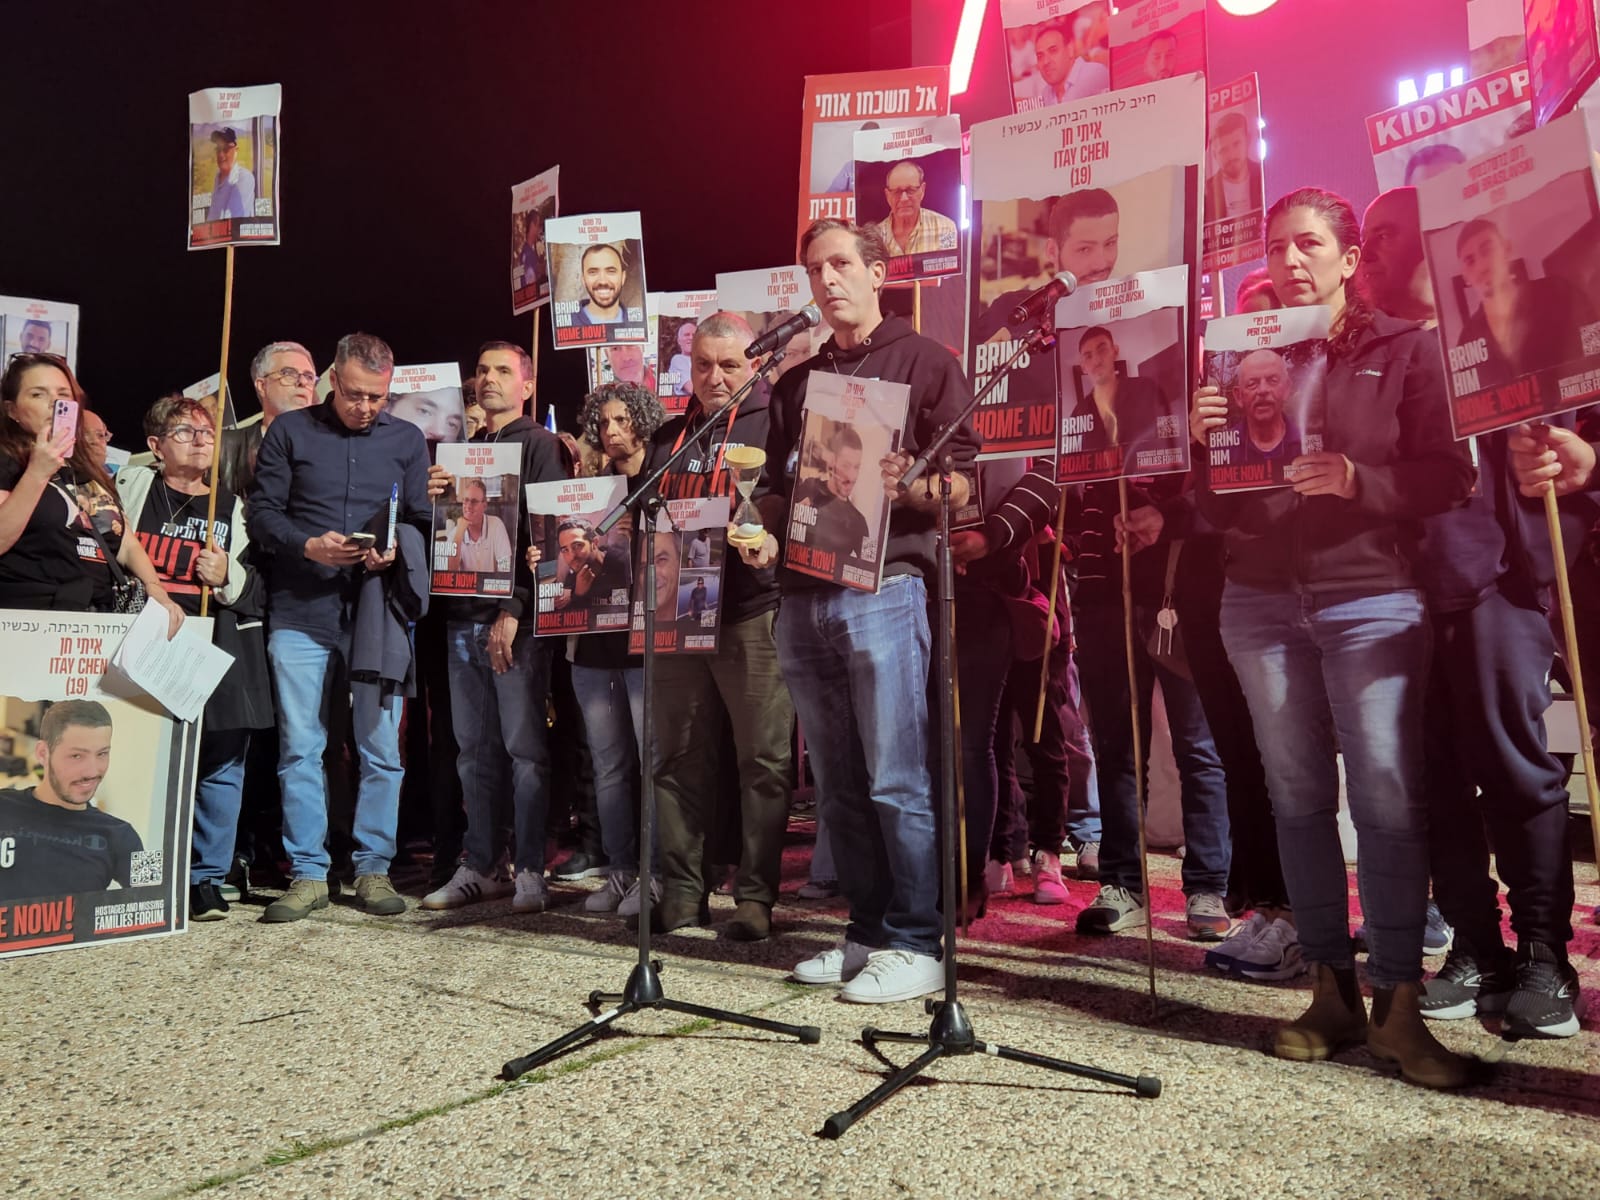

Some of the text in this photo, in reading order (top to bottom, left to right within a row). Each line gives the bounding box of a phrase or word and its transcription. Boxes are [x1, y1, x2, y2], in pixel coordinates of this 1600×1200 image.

[815, 85, 938, 118] אל תשכחו אותי
[1092, 98, 1126, 117] לחזור
[1130, 93, 1156, 110] חייב
[1376, 69, 1530, 146] KIDNAPP
[1062, 121, 1103, 148] איתי חן
[883, 140, 910, 150] ABRAHAM
[1054, 141, 1110, 169] ITAY CHEN
[1070, 165, 1092, 189] (19)
[809, 198, 842, 220] בבית
[1214, 216, 1257, 235] Berman
[780, 271, 795, 282] איתי
[768, 283, 799, 297] ITAY CHEN
[554, 300, 580, 314] BRING
[1088, 290, 1145, 312] ROM BRASLAVSKI
[556, 314, 573, 328] HIM
[557, 326, 582, 342] HOME
[582, 324, 607, 339] NOW!
[1246, 325, 1281, 337] PERI CHAIM
[1258, 335, 1272, 346] (79)
[976, 338, 1031, 374] BRING
[1448, 338, 1489, 373] BRING
[660, 372, 681, 385] BRING
[1452, 368, 1481, 398] HIM
[974, 374, 1009, 406] HIM
[1456, 387, 1497, 424] HOME
[972, 404, 1055, 440] HOME NO
[1062, 414, 1094, 436] BRING
[1061, 434, 1083, 455] HIM
[1210, 430, 1240, 448] BRING
[1060, 453, 1093, 475] HOME
[1210, 450, 1230, 466] HIM
[1211, 465, 1241, 483] HOME
[576, 492, 594, 502] COHEN
[792, 502, 818, 526] BRING
[790, 522, 807, 544] HIM
[434, 542, 458, 557] BRING
[788, 543, 836, 573] HOME NOW!
[433, 572, 456, 588] HOME
[456, 572, 478, 588] NOW!
[538, 582, 565, 598] BRING
[538, 596, 555, 613] HIM
[94, 622, 129, 635] לחזור
[538, 612, 562, 628] HOME
[563, 610, 588, 627] NOW!
[60, 637, 103, 657] איתי חן
[49, 658, 109, 675] ITAY CHEN
[66, 677, 89, 697] (19)
[13, 896, 75, 937] NOW!
[94, 899, 165, 917] HOSTAGES AND MISSING
[94, 910, 165, 931] FAMILIES FORUM
